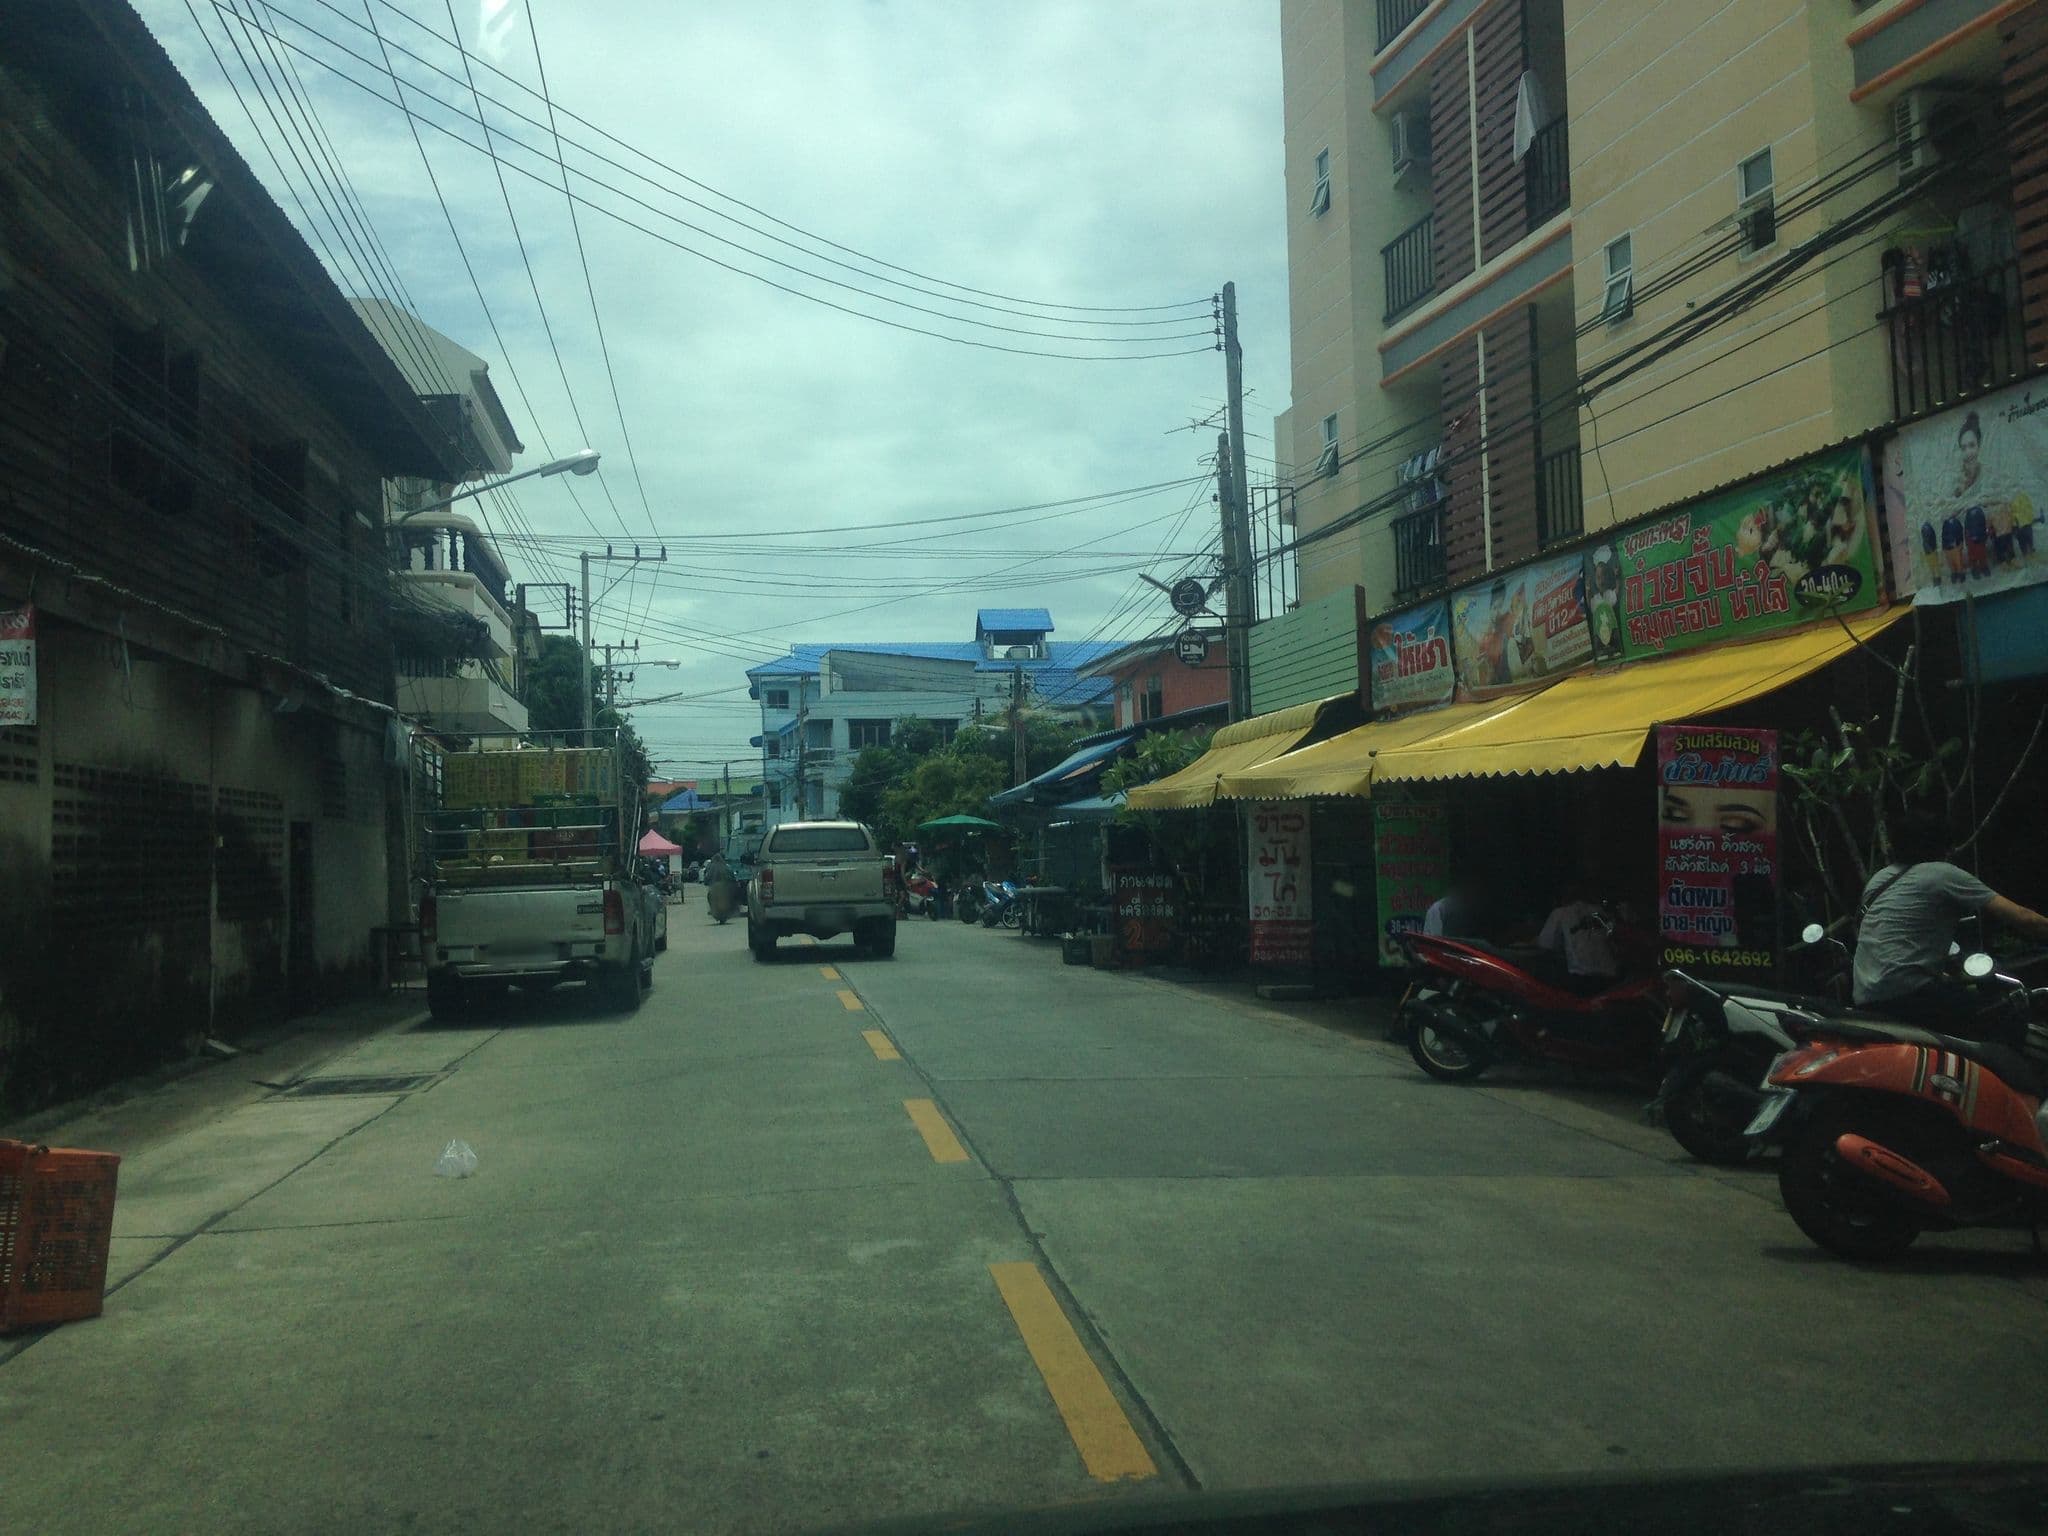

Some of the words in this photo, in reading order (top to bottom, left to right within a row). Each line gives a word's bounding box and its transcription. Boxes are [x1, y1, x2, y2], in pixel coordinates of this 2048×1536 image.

[1627, 594, 1722, 650] หมูกรอบ
[1674, 732, 1760, 756] ร้านเสริมสวย
[1254, 804, 1305, 833] ข้าว
[1258, 838, 1301, 867] มัน
[1739, 859, 1748, 874] 3
[1263, 871, 1297, 902] ไก่
[1667, 878, 1728, 908] ตัดผม
[1662, 911, 1734, 935] ชาย-หญิง
[1664, 947, 1773, 967] 096-1642692
